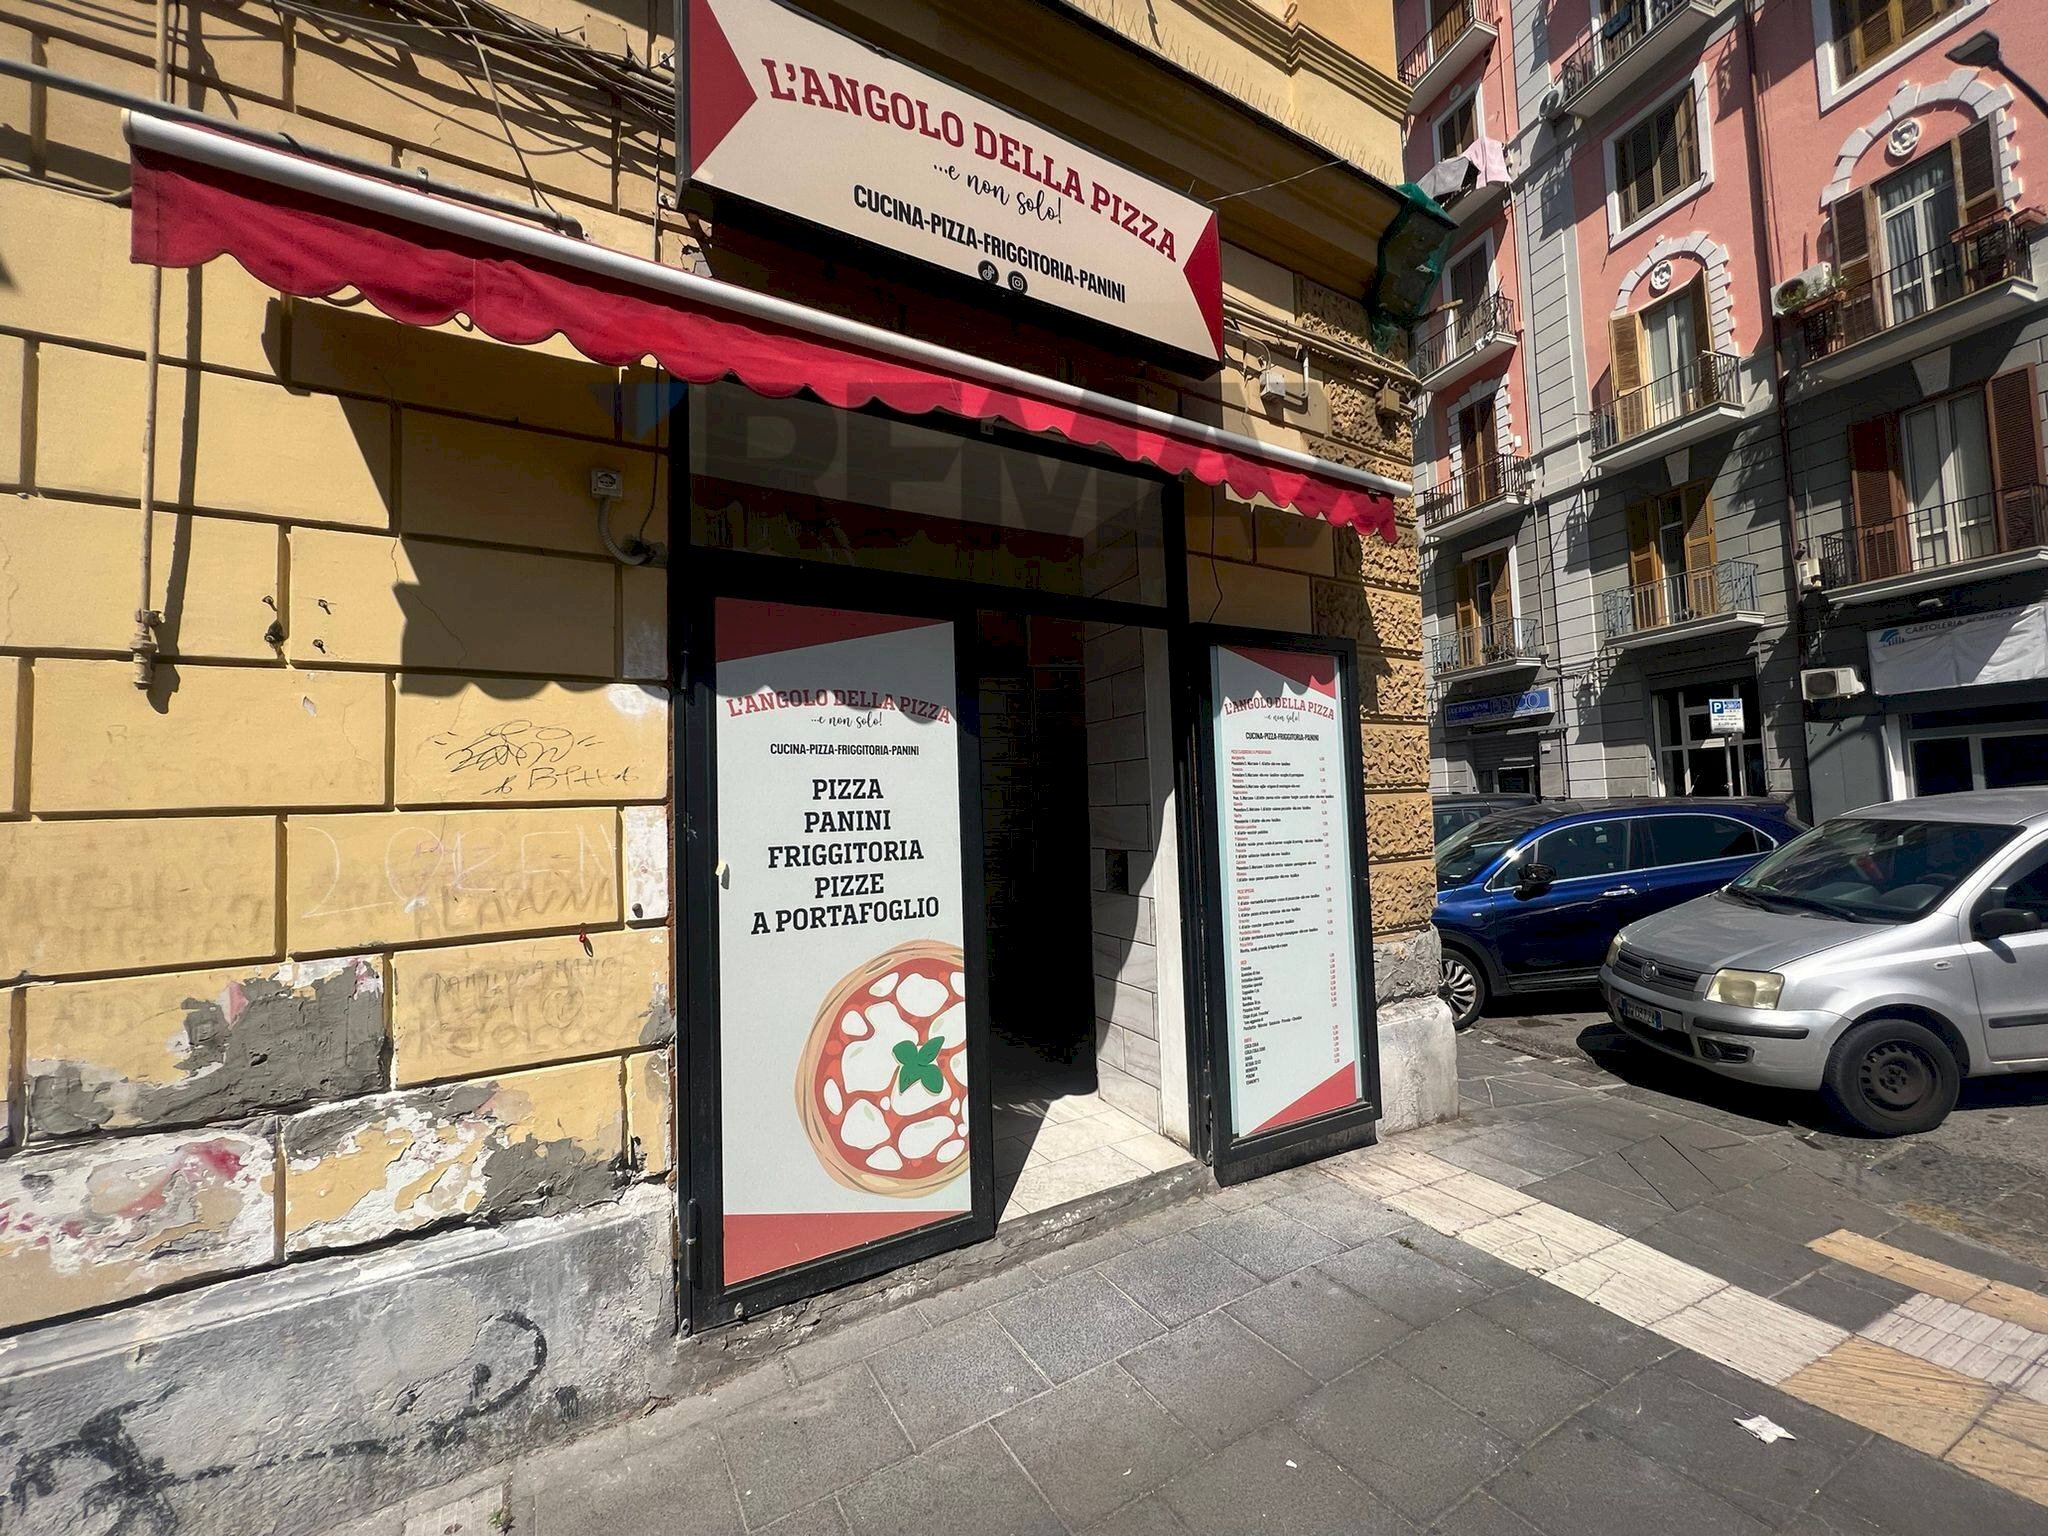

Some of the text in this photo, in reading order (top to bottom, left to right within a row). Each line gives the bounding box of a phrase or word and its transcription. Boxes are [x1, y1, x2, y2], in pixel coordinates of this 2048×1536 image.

[761, 57, 1178, 262] L'ANGOLO DELLA PIZZA
[966, 172, 1011, 207] non
[1016, 189, 1063, 225] solo!
[853, 184, 1126, 304] CUCINA-PIZZA-FRIGGITORIA-PANINI
[1905, 620, 1963, 635] CARTOLERIA
[726, 689, 951, 724] L'ANGOLO DELLA PIZZA
[829, 715, 853, 727] non
[856, 711, 883, 729] solo!
[1275, 696, 1306, 712] DELLA
[1307, 702, 1335, 720] PIZZA
[770, 743, 920, 756] CUCINA-PIZZA-FRIGGITORIA-PANINI
[812, 778, 884, 800] PIZZA
[804, 809, 891, 833] PANINI
[768, 839, 924, 869] FRIGGITORIA
[814, 872, 885, 899] PIZZE
[751, 896, 940, 935] A PORTAFOGLIO
